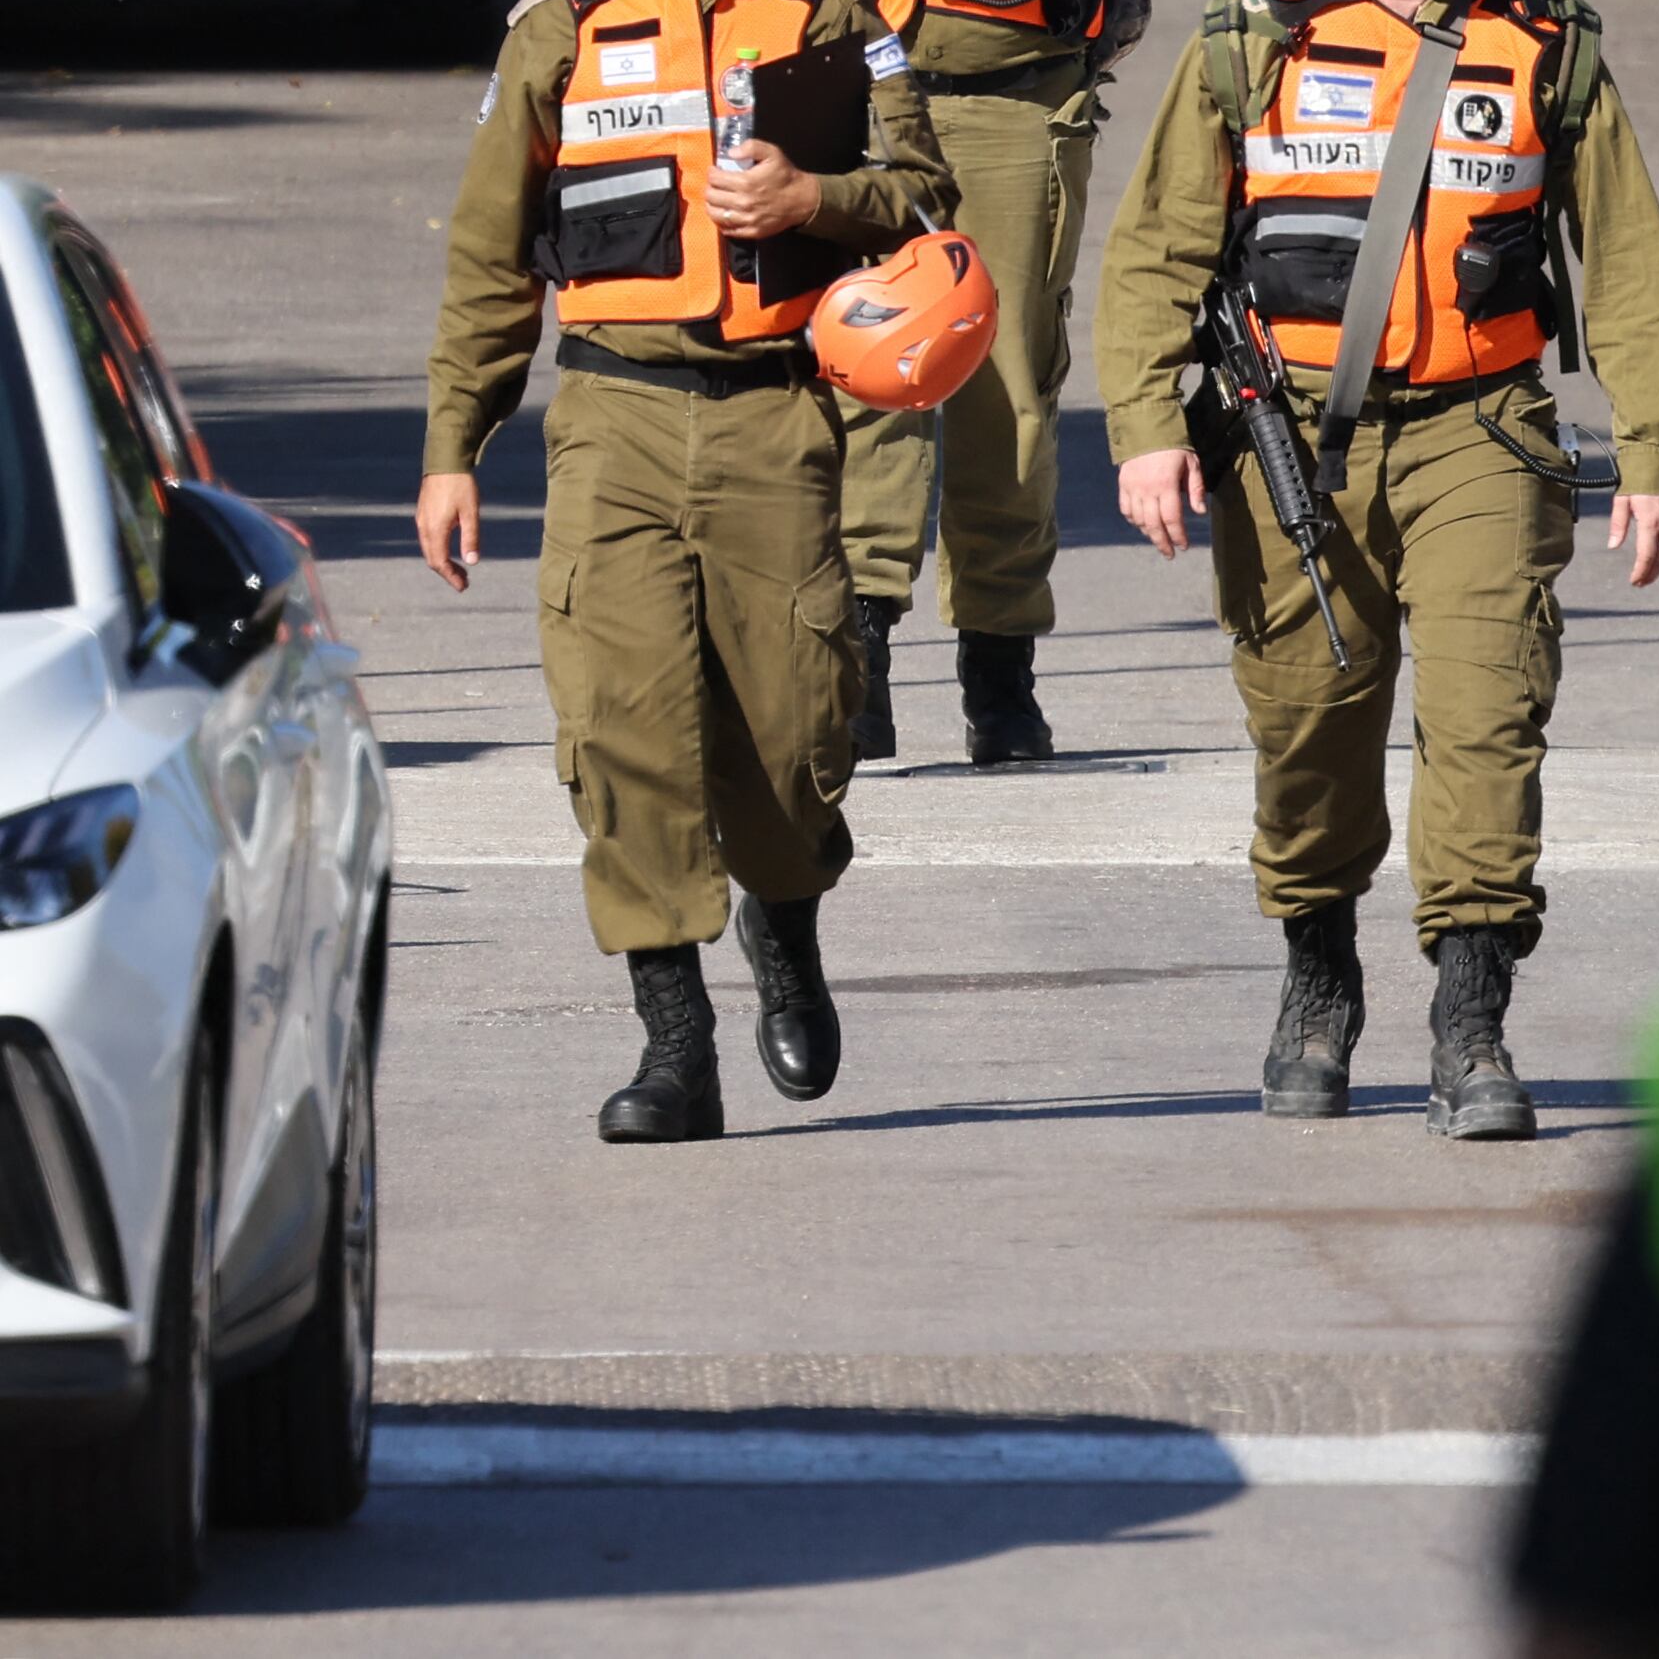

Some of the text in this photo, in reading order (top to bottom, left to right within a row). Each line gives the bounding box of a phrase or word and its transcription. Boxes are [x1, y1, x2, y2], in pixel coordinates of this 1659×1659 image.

[586, 104, 664, 137] העורף
[1283, 141, 1517, 187] פיקוד העורף
